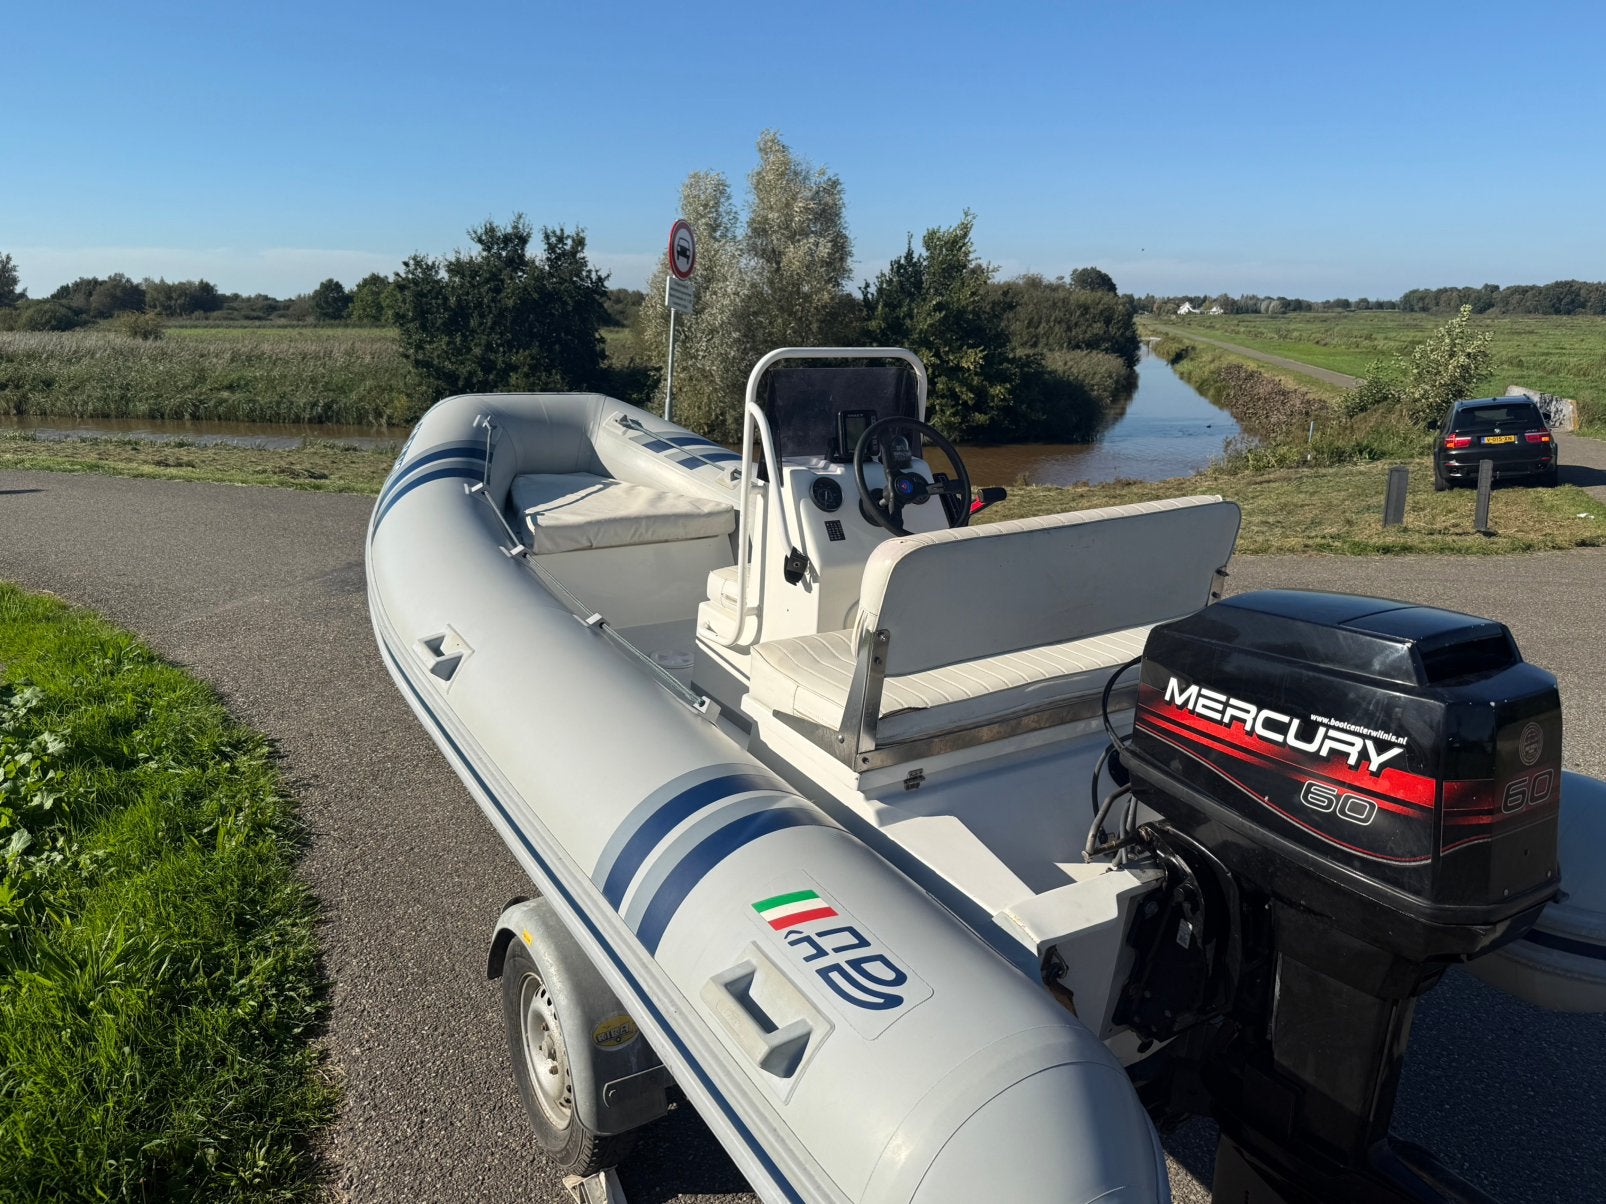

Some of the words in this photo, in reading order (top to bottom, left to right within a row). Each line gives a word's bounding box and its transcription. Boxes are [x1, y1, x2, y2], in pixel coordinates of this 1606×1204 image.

[1164, 677, 1403, 772] MERCURY
[1310, 713, 1408, 746] www.bootcenterwilnis.nl
[1300, 780, 1378, 826] 60
[1501, 768, 1554, 814] 60
